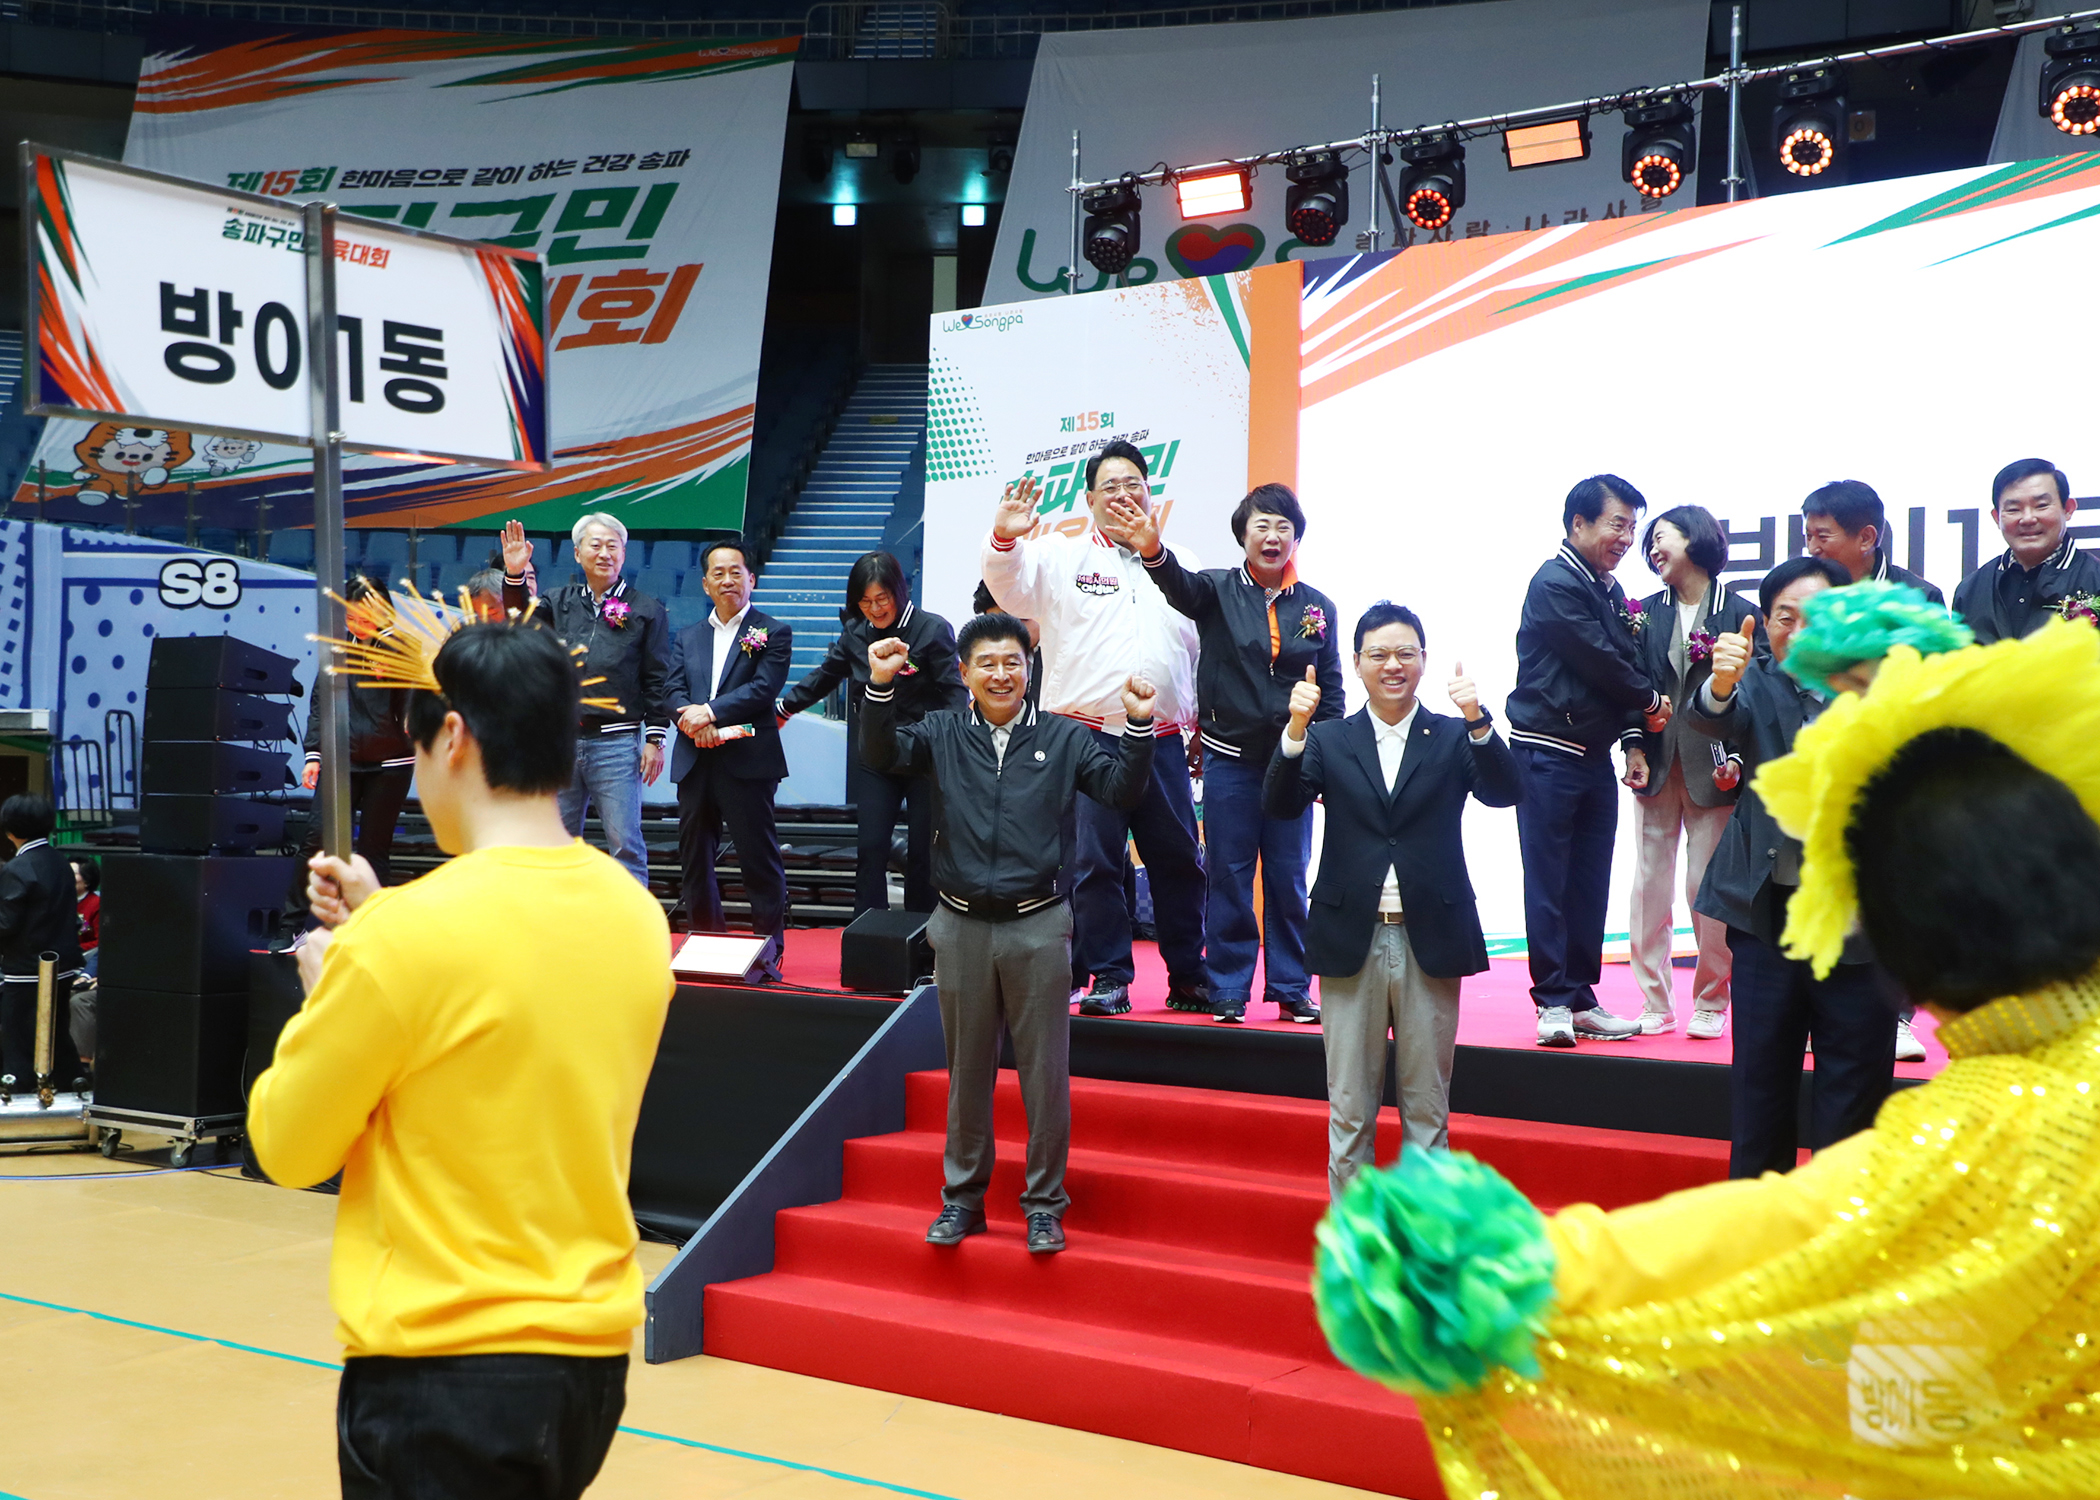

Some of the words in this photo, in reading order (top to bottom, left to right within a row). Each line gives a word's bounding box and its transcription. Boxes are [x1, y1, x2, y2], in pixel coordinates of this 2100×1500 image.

[226, 166, 339, 197] 제15회
[338, 168, 469, 190] 한마음으로
[471, 165, 525, 188] 같이
[527, 158, 578, 182] 하는
[581, 153, 636, 174] 건강
[639, 148, 692, 172] 송파
[1060, 411, 1115, 433] 제15회
[1025, 446, 1069, 465] 한마음으로
[1070, 441, 1089, 456] 같이
[1089, 438, 1108, 451] 하는
[1130, 429, 1150, 443] 송파
[158, 558, 242, 610] S8
